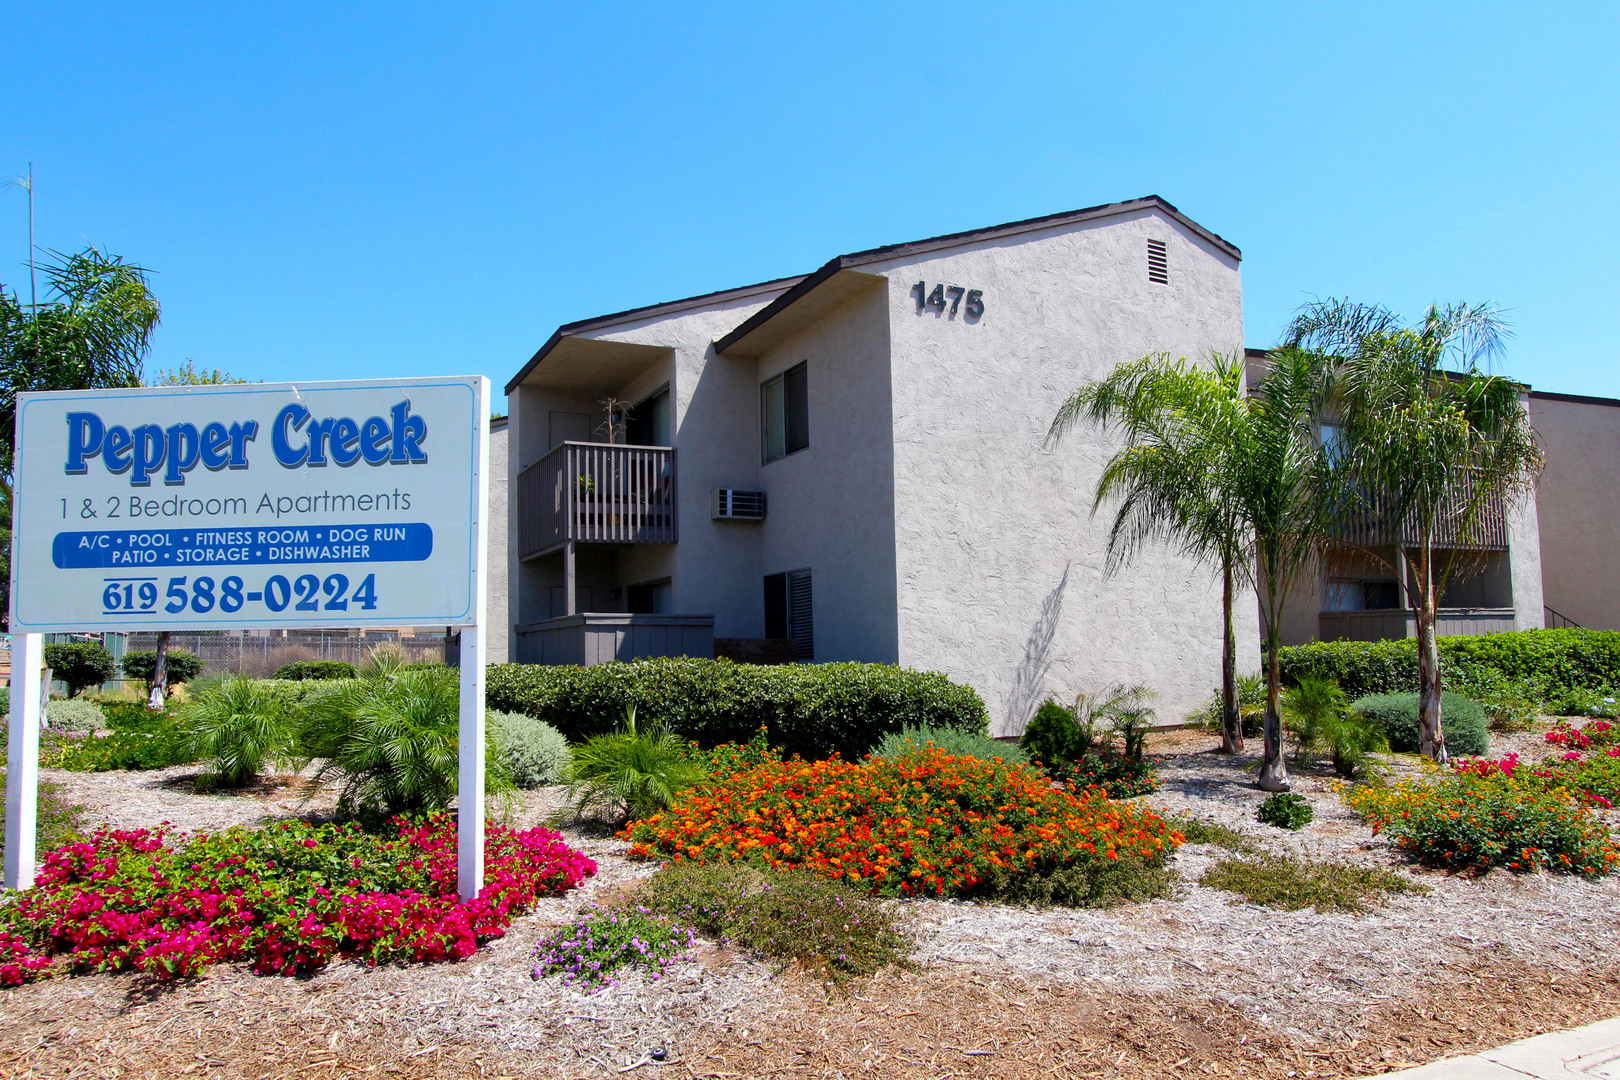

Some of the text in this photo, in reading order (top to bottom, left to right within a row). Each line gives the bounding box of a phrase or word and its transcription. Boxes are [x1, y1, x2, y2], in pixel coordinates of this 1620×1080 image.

[912, 280, 985, 318] 1475
[64, 399, 429, 486] Pepper Creek
[60, 488, 411, 519] 1 & 2 Bedroom Apartments
[79, 528, 406, 549] A/C POOL FITNESS ROOM DOG RUN
[112, 545, 370, 563] PATIO STORAGE DISHWASHER
[103, 573, 378, 613] 619 588-0224
